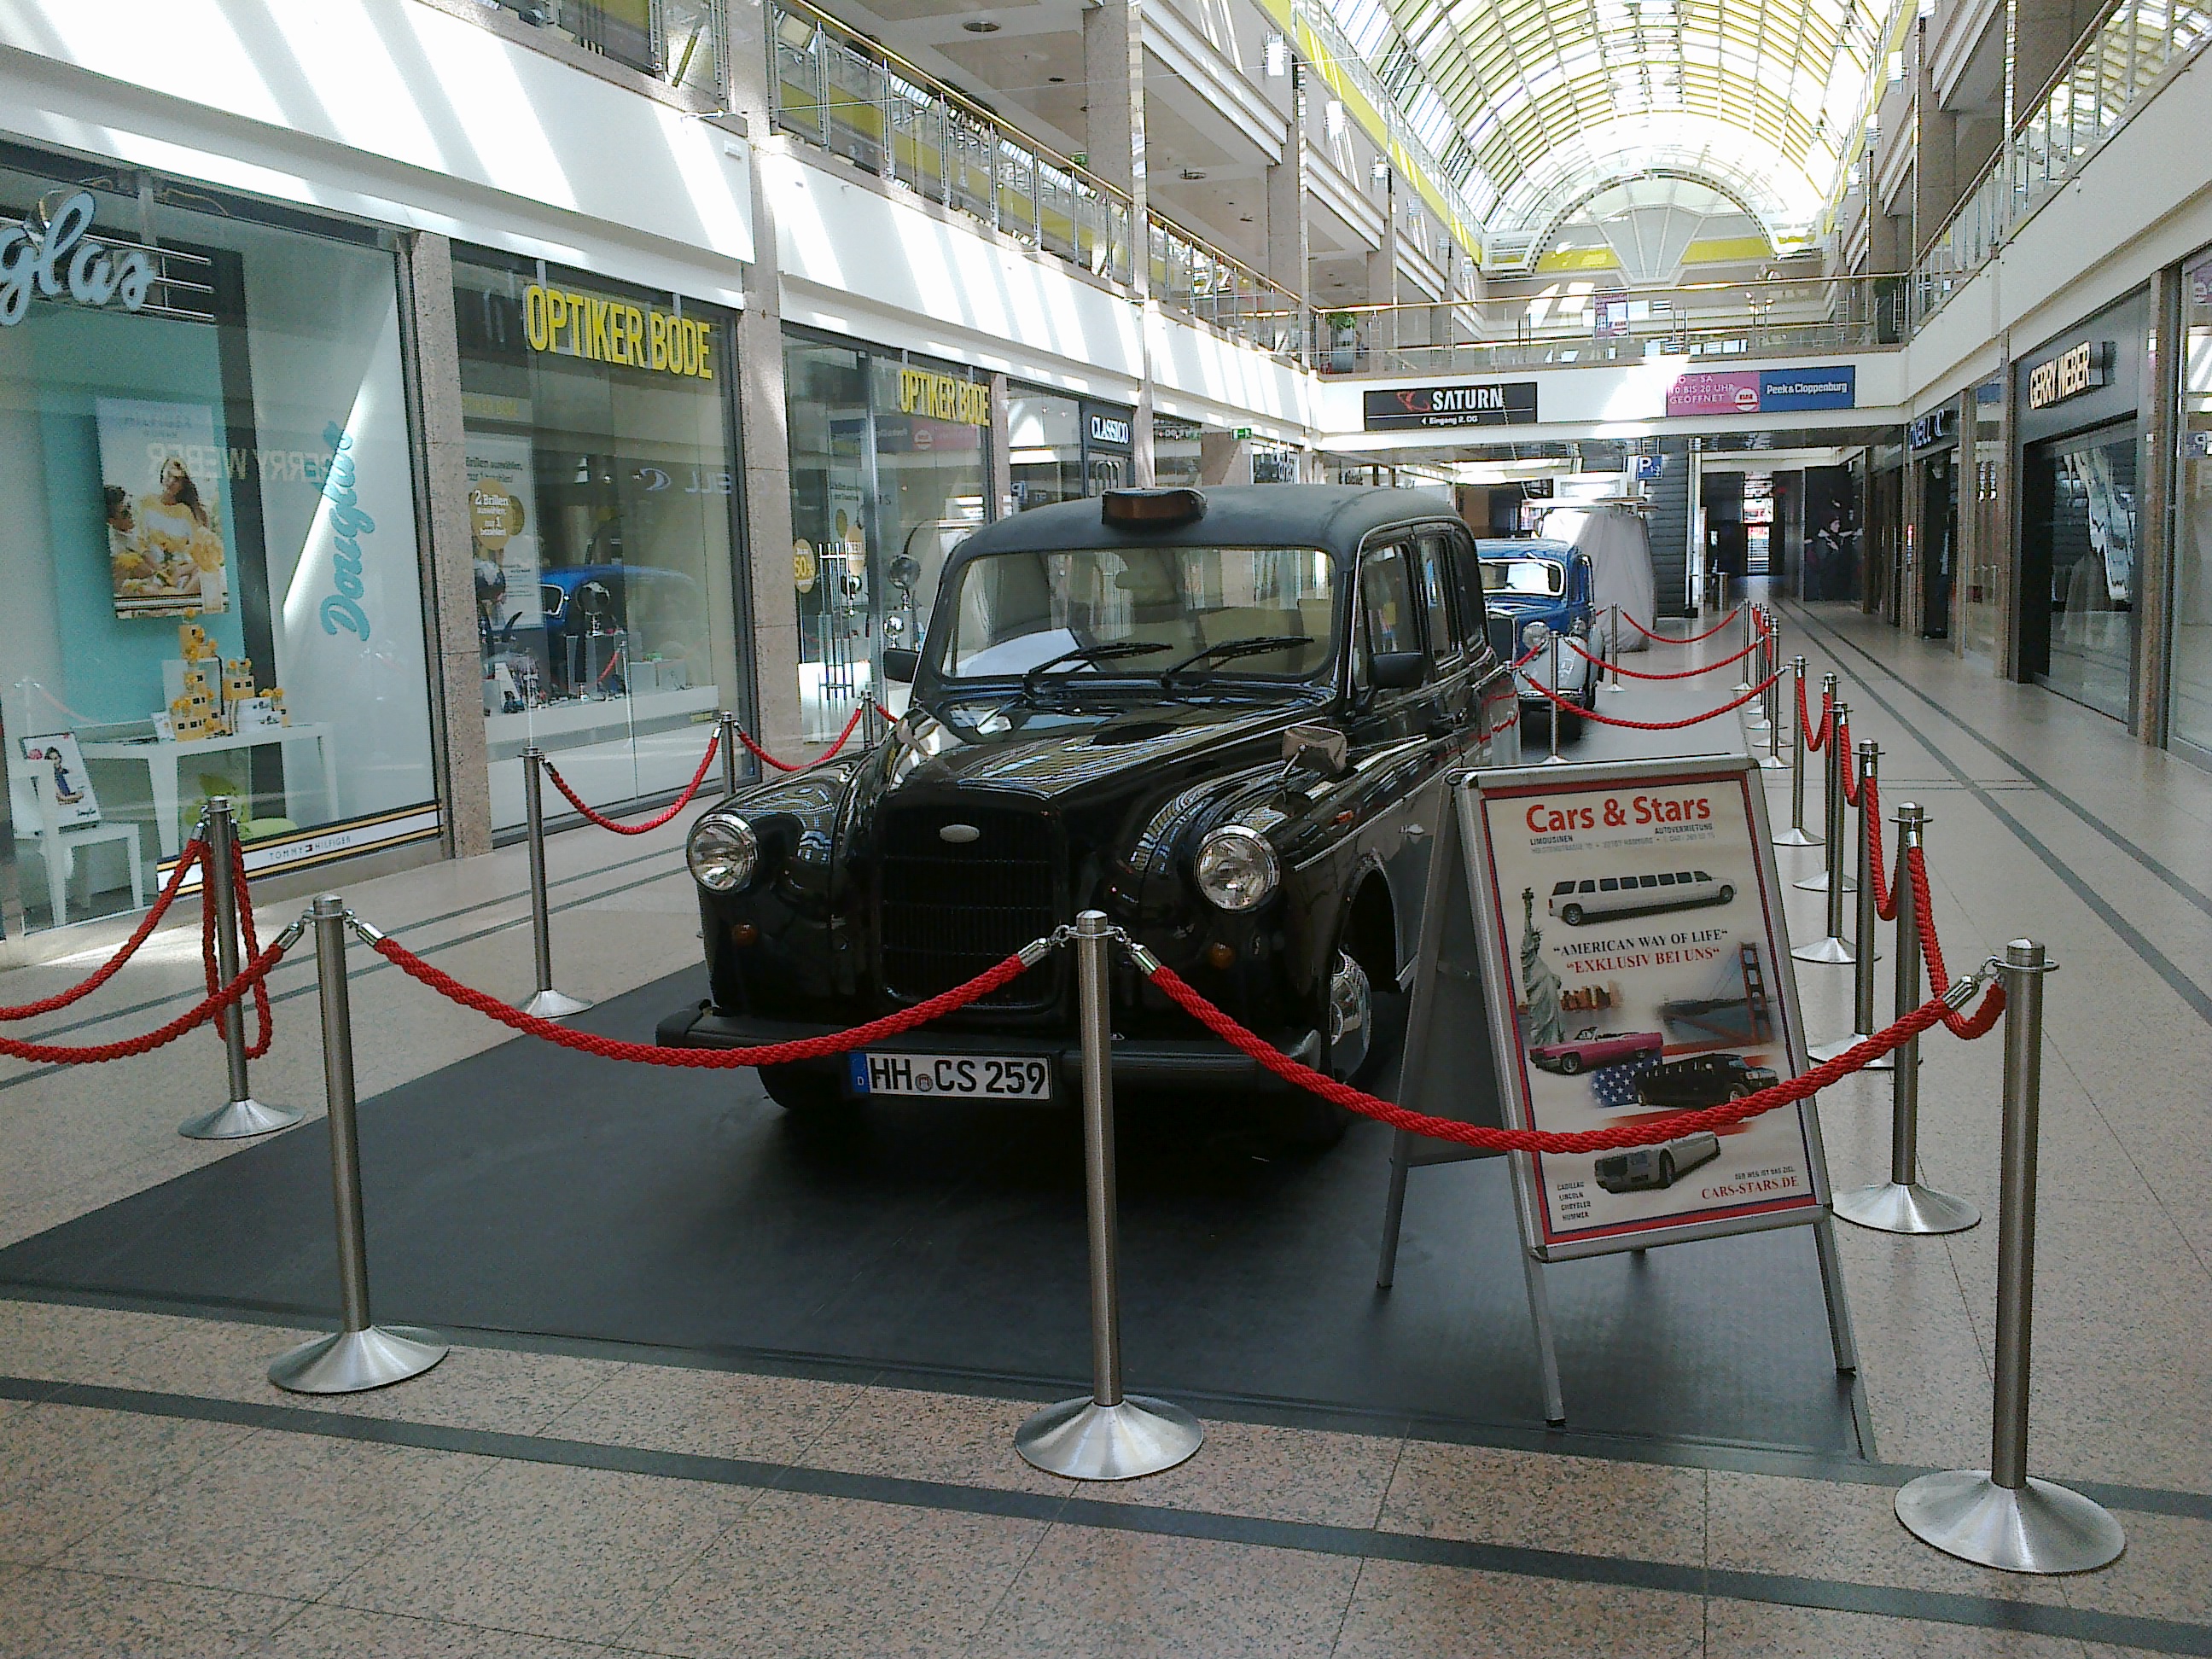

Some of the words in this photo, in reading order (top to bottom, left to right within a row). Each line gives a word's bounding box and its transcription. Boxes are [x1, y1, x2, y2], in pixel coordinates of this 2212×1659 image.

[525, 284, 646, 369] OPTIKER
[649, 310, 713, 380] BODE
[1700, 375, 1714, 384] SA
[2029, 358, 2057, 410] GERRY
[2057, 341, 2090, 399] WEBER
[900, 367, 957, 421] OPTIKER
[958, 379, 990, 428] BODE
[1683, 384, 1698, 394] BIS
[1700, 384, 1712, 393] 20
[1714, 383, 1735, 393] UHR
[1432, 387, 1504, 411] SATURN
[1091, 416, 1129, 444] CLASSICO
[1429, 416, 1458, 427] Eingang
[1639, 456, 1652, 474] P
[474, 489, 483, 506] 2
[482, 494, 509, 506] Brillen
[496, 515, 502, 527] 1
[1526, 804, 1595, 833] Cars
[1603, 798, 1627, 827] &
[1633, 796, 1711, 824] Stars
[269, 847, 303, 860] TOMMY
[314, 835, 352, 850] HILFIGER
[1529, 835, 1574, 846] LIMOUSINEN
[1638, 934, 1667, 947] WAY
[1670, 932, 1688, 945] OF
[1656, 949, 1681, 965] BEI
[857, 1075, 864, 1086] D
[869, 1057, 913, 1091] HH
[934, 1059, 977, 1092] CS
[985, 1061, 1046, 1095] 259
